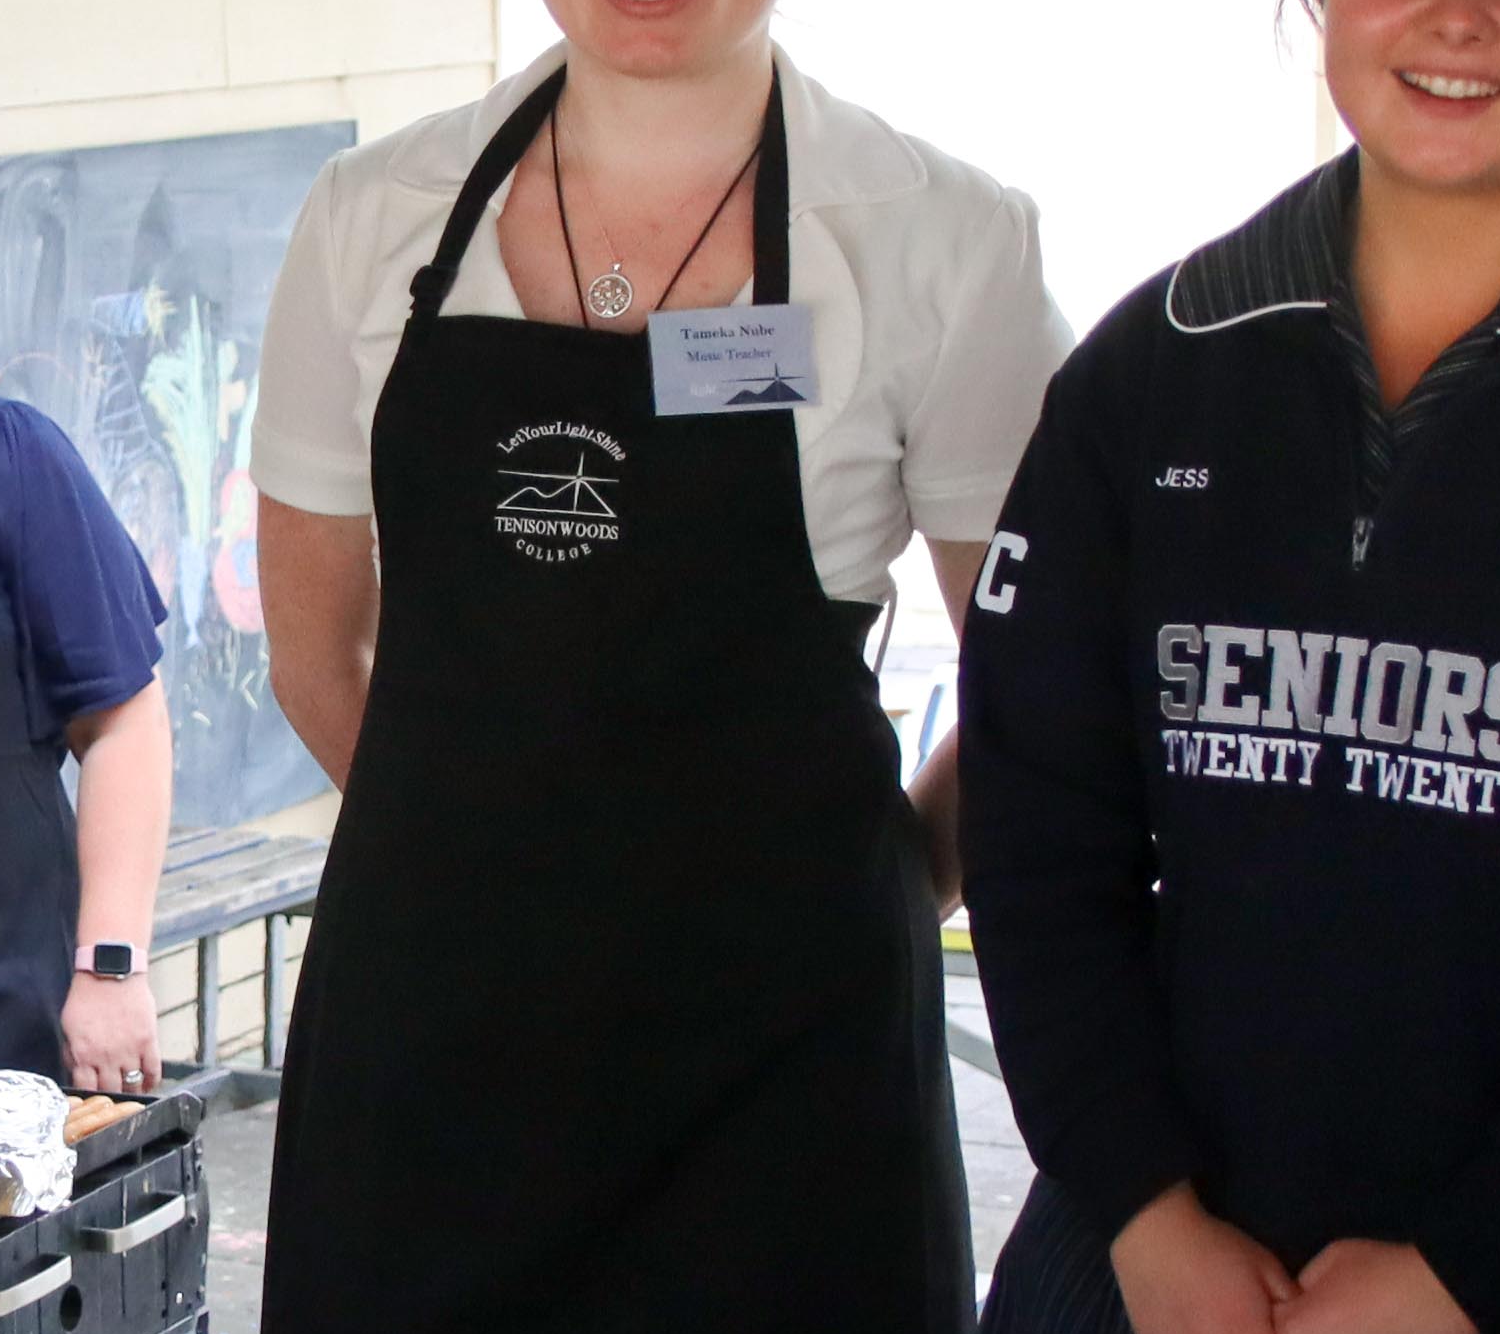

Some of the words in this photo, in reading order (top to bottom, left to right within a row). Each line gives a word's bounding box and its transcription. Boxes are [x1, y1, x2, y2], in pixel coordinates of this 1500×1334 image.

[1155, 467, 1209, 488] JESS
[494, 516, 558, 536] TENISON
[559, 521, 619, 540] WOODS
[516, 538, 592, 562] COLLEGE
[975, 530, 1028, 614] C
[1161, 729, 1321, 786] TWENTY
